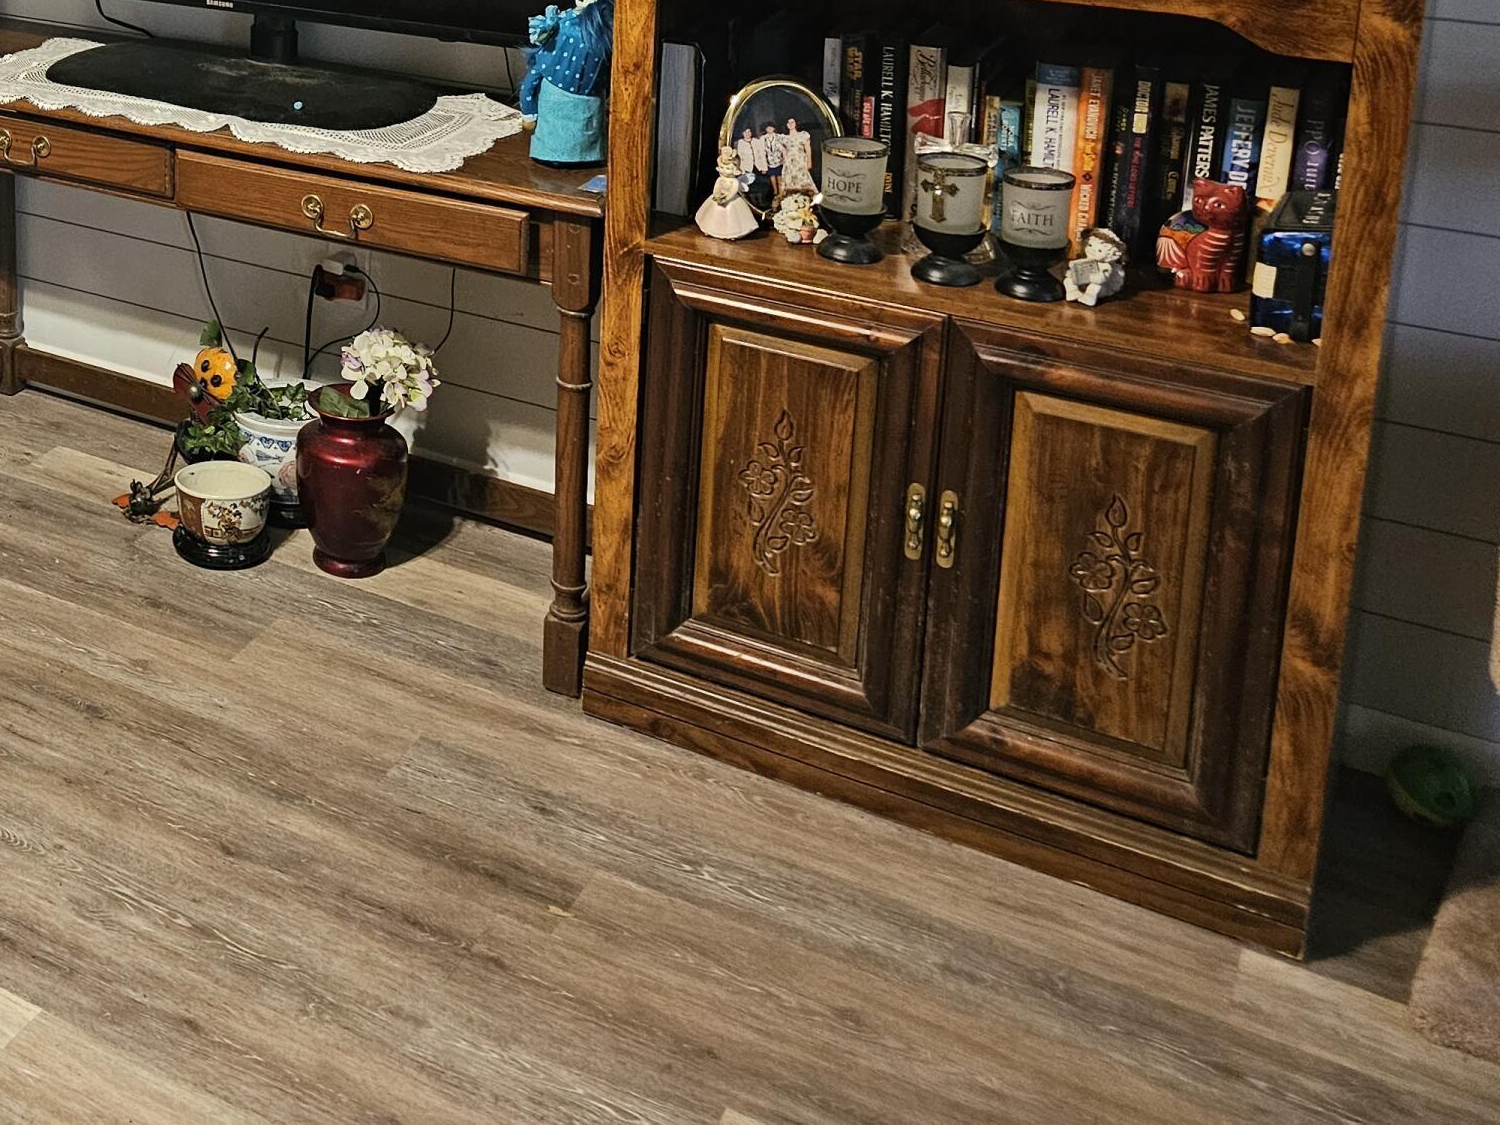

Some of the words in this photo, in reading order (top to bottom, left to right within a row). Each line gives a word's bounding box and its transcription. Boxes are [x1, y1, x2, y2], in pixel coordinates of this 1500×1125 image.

[881, 46, 895, 86] LAURELL
[1089, 74, 1103, 97] JANET
[1134, 80, 1152, 112] DOCTOR
[1046, 88, 1061, 125] LAURELL
[1085, 99, 1100, 140] EVANOVICH
[1202, 84, 1220, 123] JAMES
[1271, 93, 1295, 127] Jude
[1043, 138, 1056, 168] HAMILT
[1194, 125, 1215, 178] PATTERS
[1230, 105, 1256, 171] JEFFERY
[1258, 130, 1288, 193] Deveraux
[827, 177, 863, 194] HOPE
[1078, 184, 1093, 211] WICKED
[1010, 208, 1054, 227] FAITH
